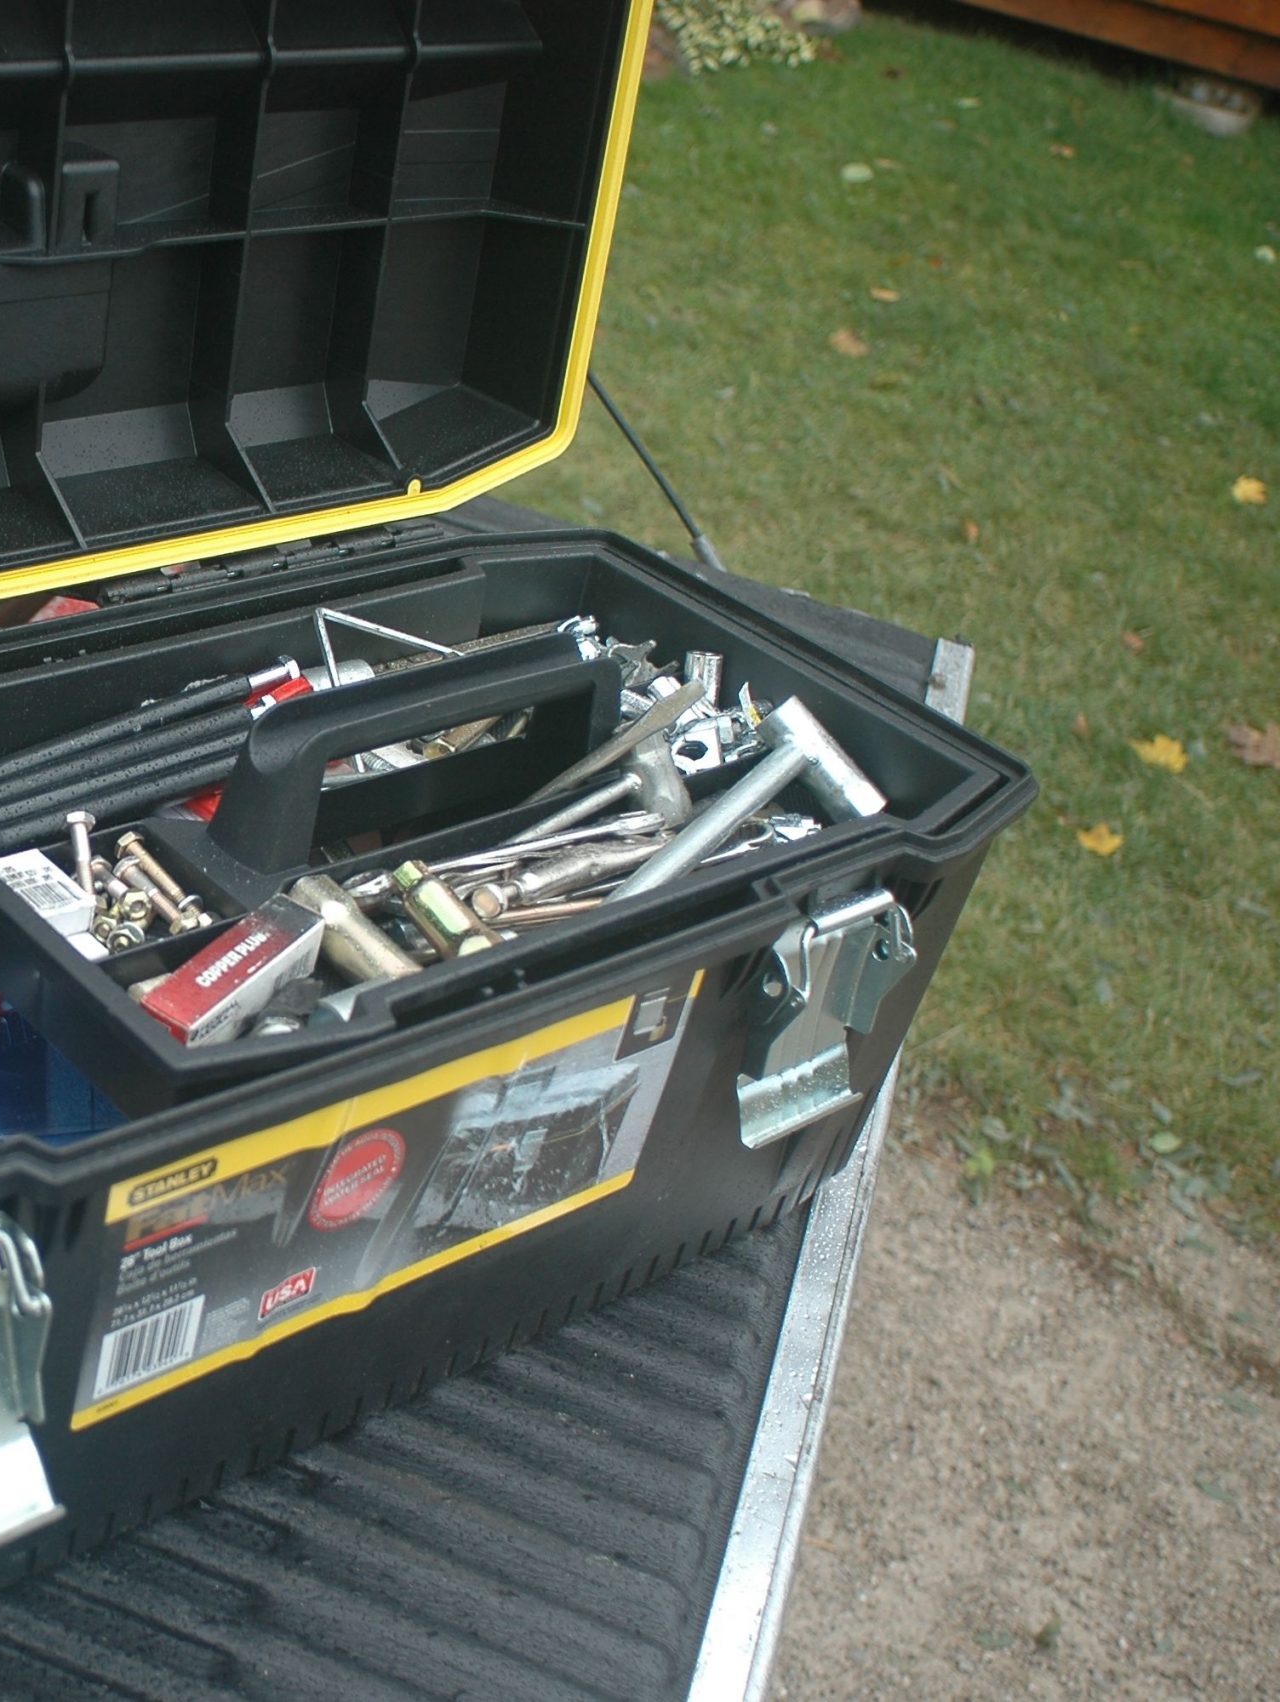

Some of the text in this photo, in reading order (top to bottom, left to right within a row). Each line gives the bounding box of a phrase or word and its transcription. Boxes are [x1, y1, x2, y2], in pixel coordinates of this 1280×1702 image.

[195, 950, 242, 988] COPPER
[131, 1162, 215, 1205] STANLEY
[169, 1232, 193, 1253] Box
[265, 1279, 308, 1311] USA
